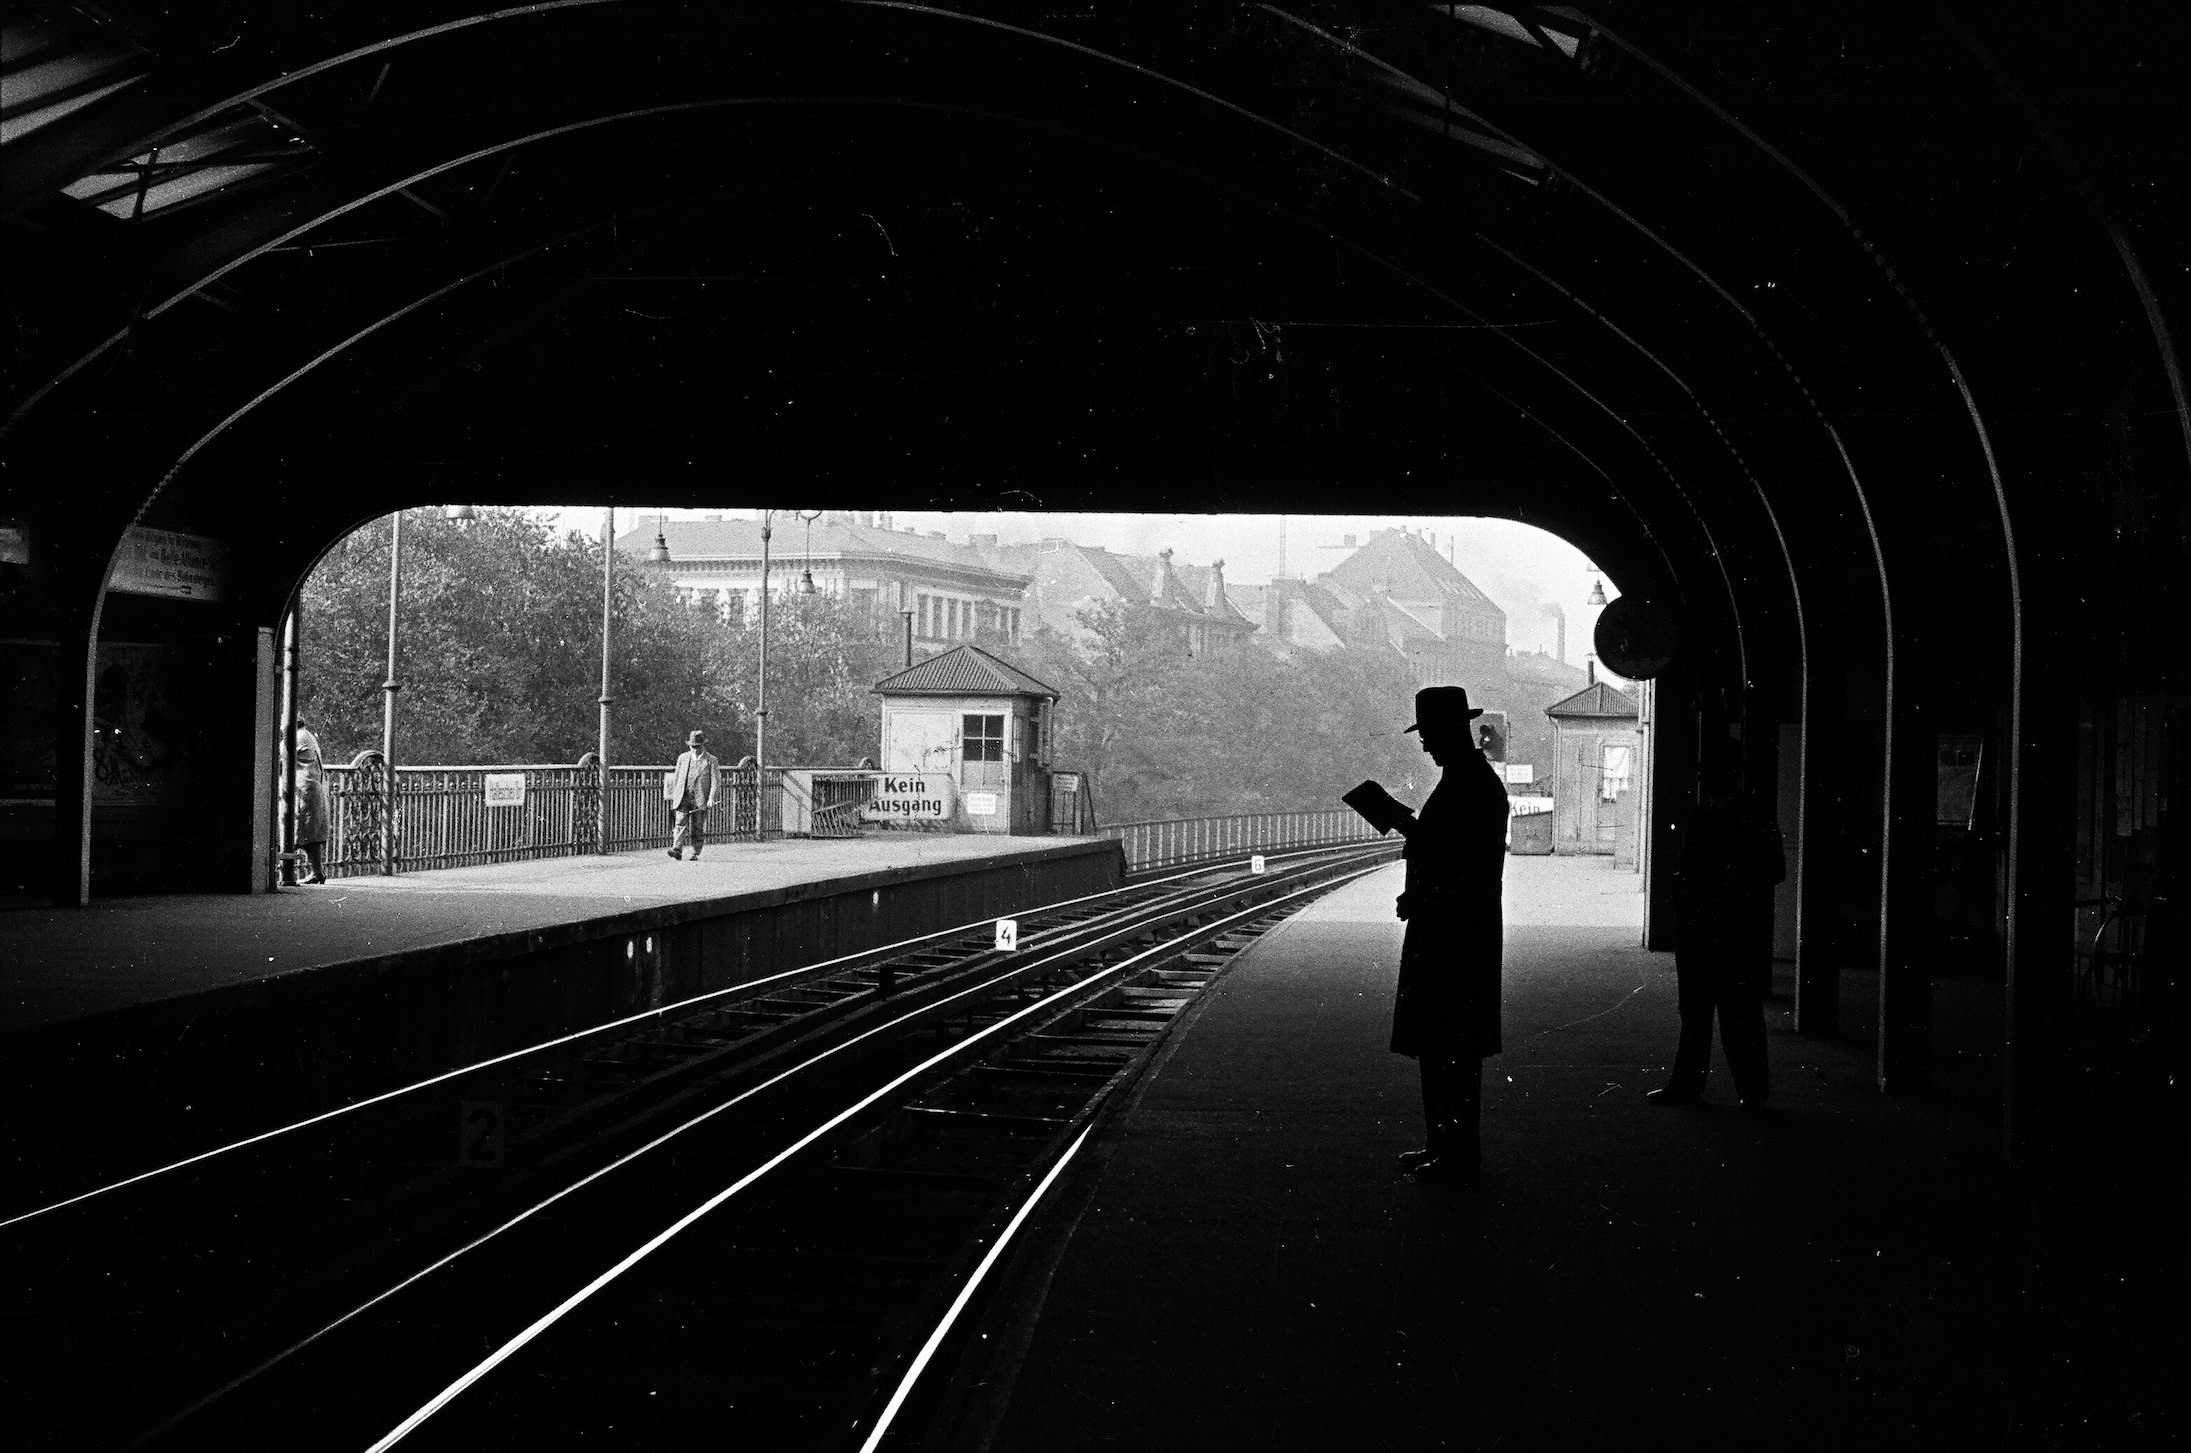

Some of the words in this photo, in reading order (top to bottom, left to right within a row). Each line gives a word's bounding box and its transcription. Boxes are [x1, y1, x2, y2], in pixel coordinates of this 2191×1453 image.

[884, 777, 926, 793] Kein
[868, 799, 942, 817] Ausgang
[1254, 858, 1262, 871] 6
[1000, 925, 1011, 946] 4
[468, 1108, 497, 1161] 2
